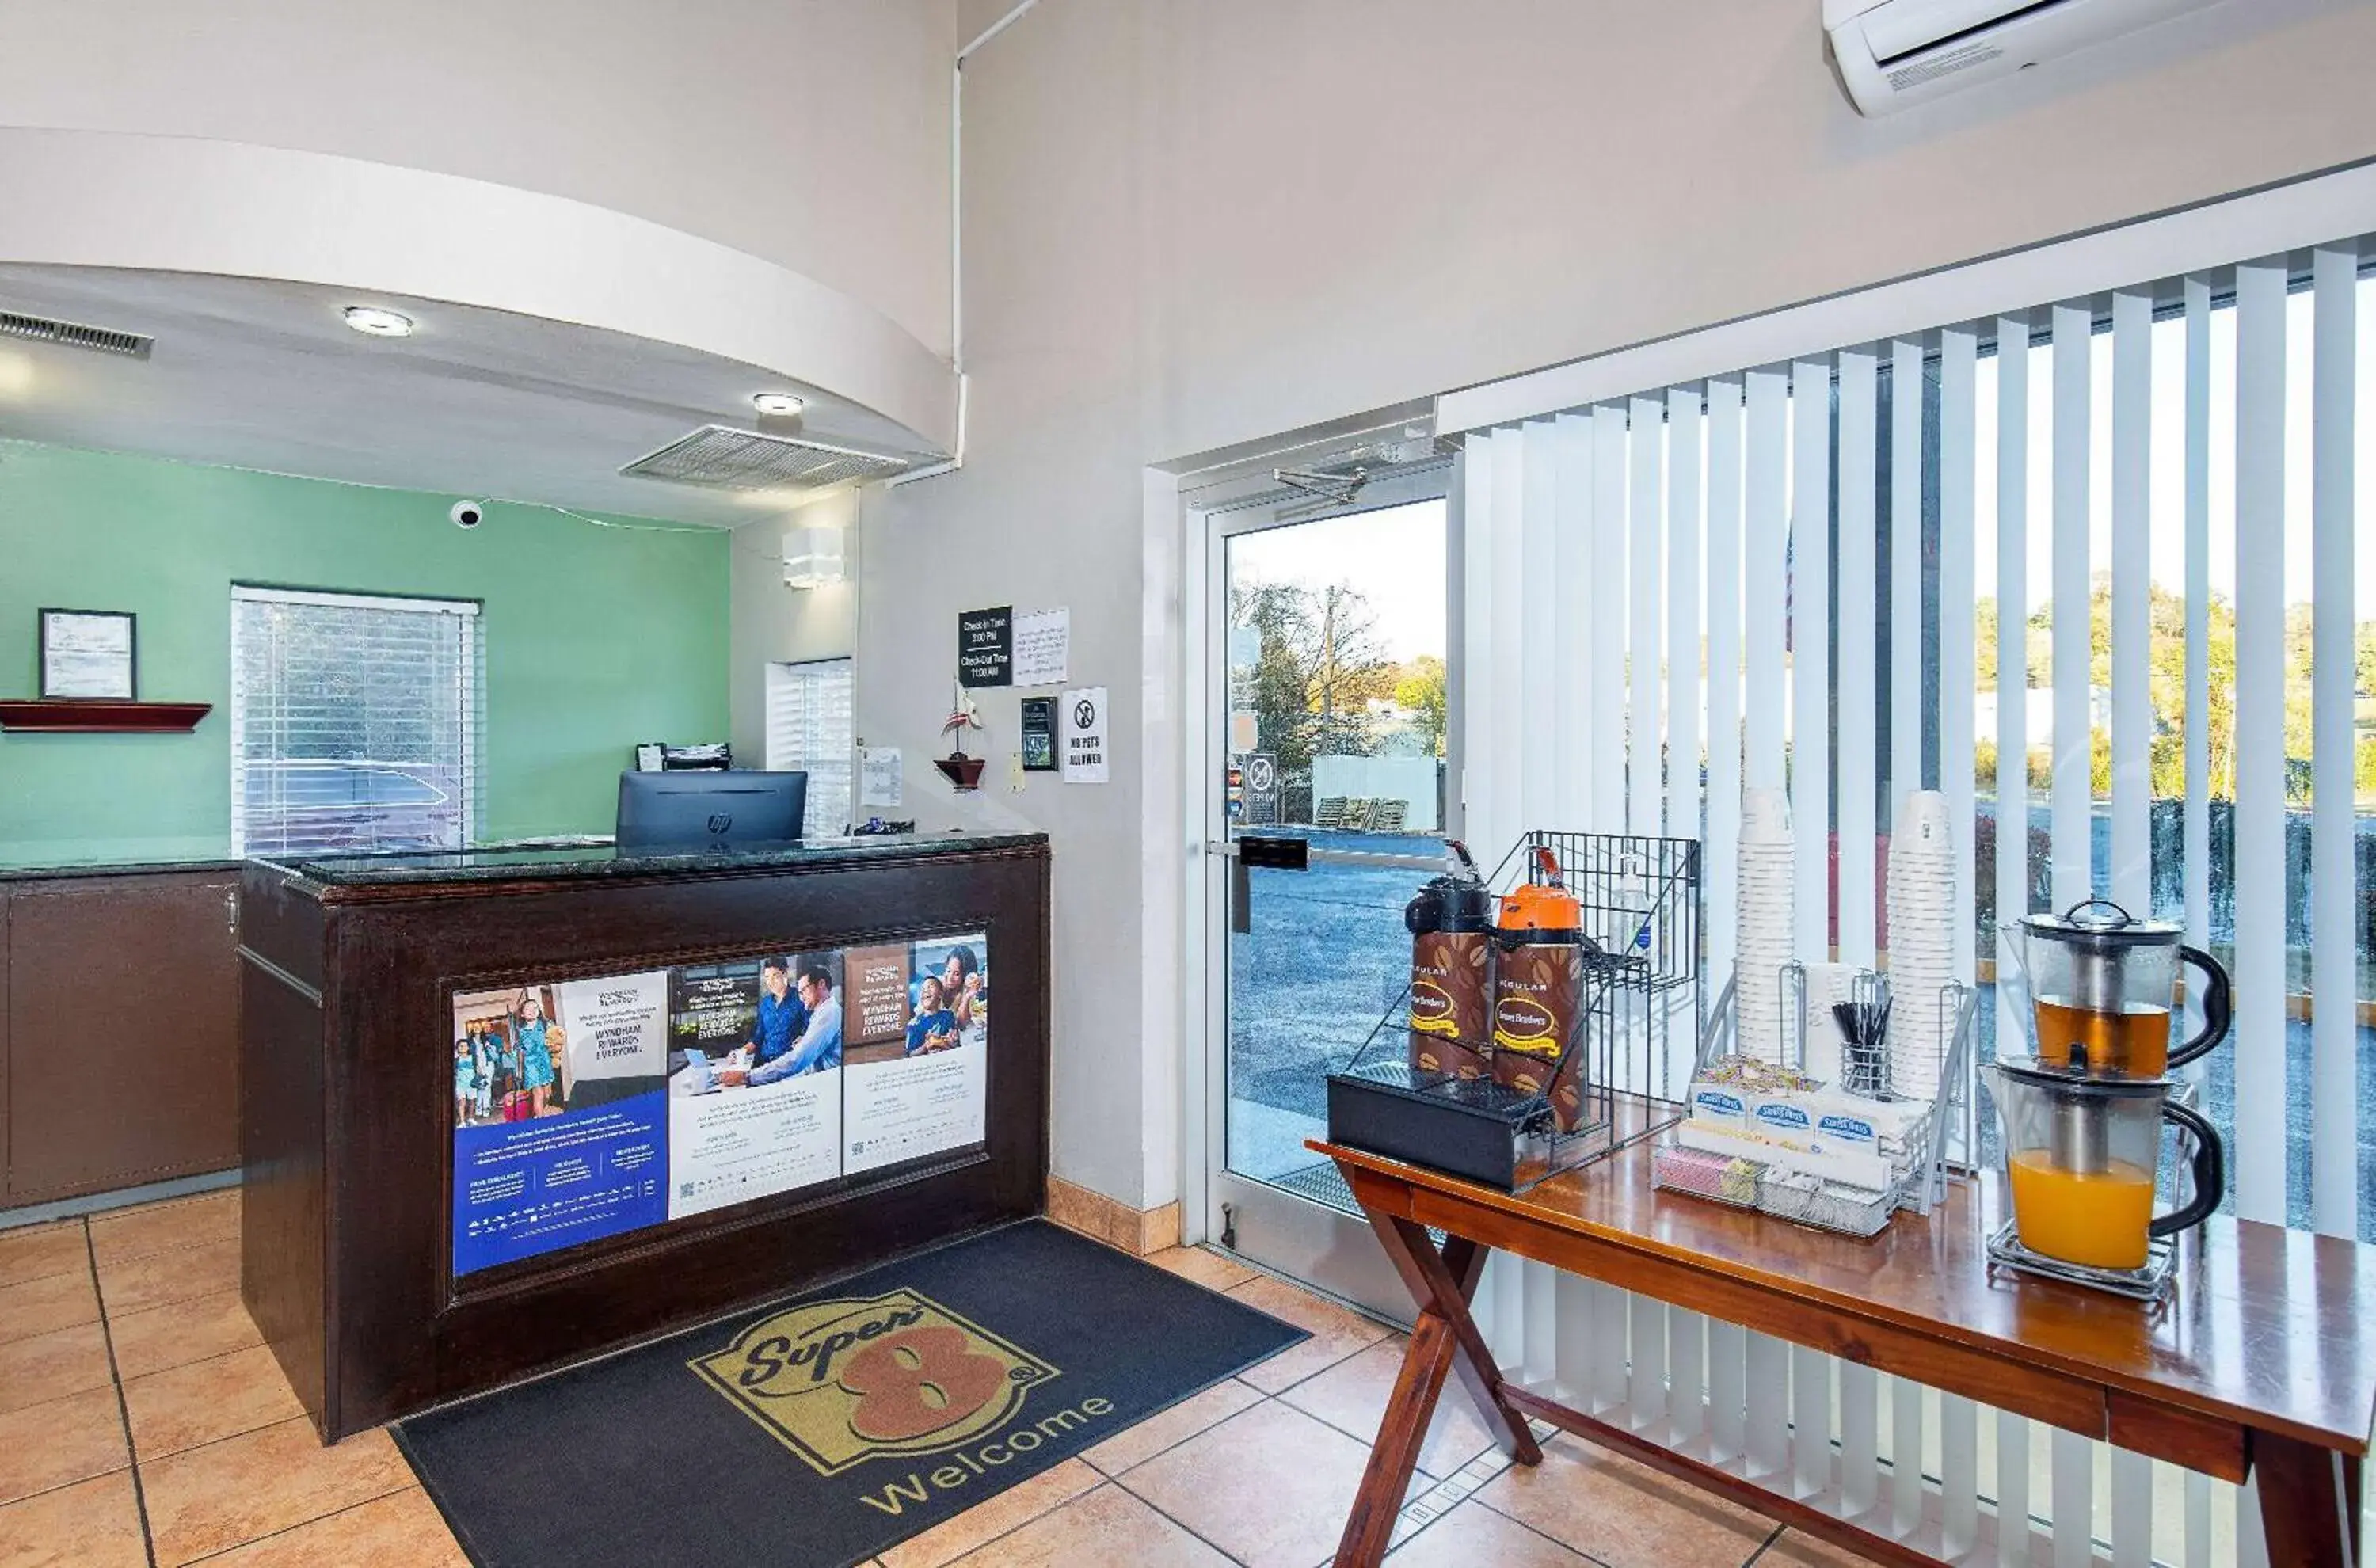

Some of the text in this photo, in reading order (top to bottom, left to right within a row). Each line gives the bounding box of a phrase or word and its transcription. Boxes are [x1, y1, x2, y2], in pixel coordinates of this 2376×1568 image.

[1070, 736, 1100, 748] NO PETS
[1069, 753, 1102, 766] ALLOWED
[595, 1024, 642, 1040] WYNDHAM
[598, 1035, 639, 1049] REWARDS
[739, 1305, 1007, 1440] Super 8
[859, 1395, 1115, 1517] Welcome
